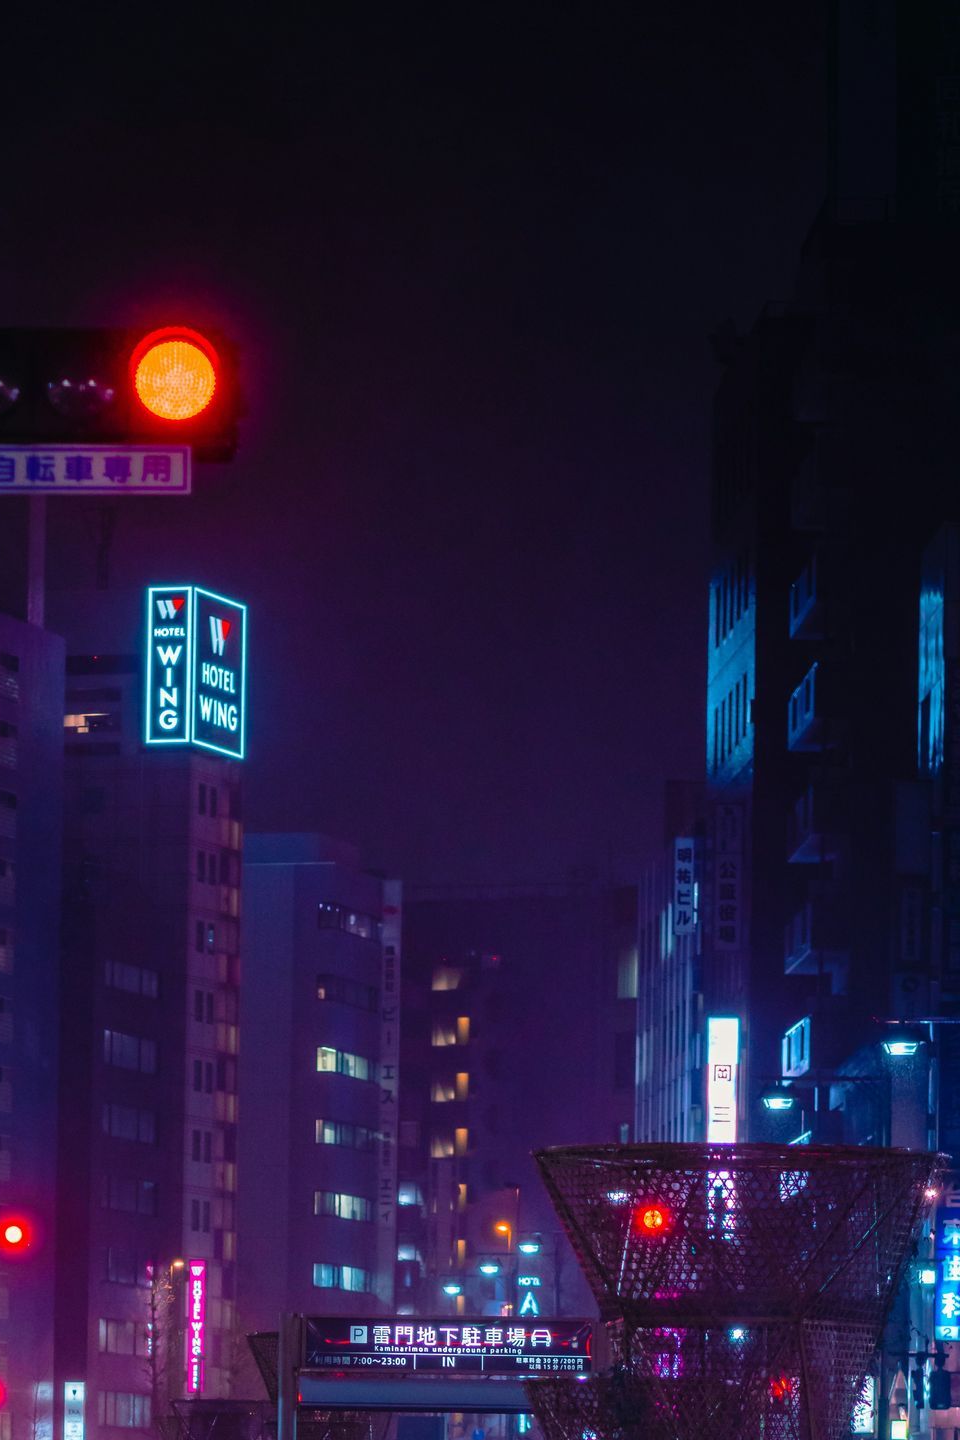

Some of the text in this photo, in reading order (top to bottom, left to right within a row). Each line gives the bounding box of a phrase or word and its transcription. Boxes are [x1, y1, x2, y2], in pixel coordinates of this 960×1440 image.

[153, 627, 186, 637] HOTEL
[156, 645, 182, 730] WING
[201, 662, 236, 694] HOTEL
[199, 694, 238, 732] WING
[192, 1280, 202, 1320] HOTEL
[372, 1325, 527, 1348] 雷門地下駐車場
[374, 1345, 523, 1355] Kaminarimon underground parking
[441, 1356, 456, 1367] IN
